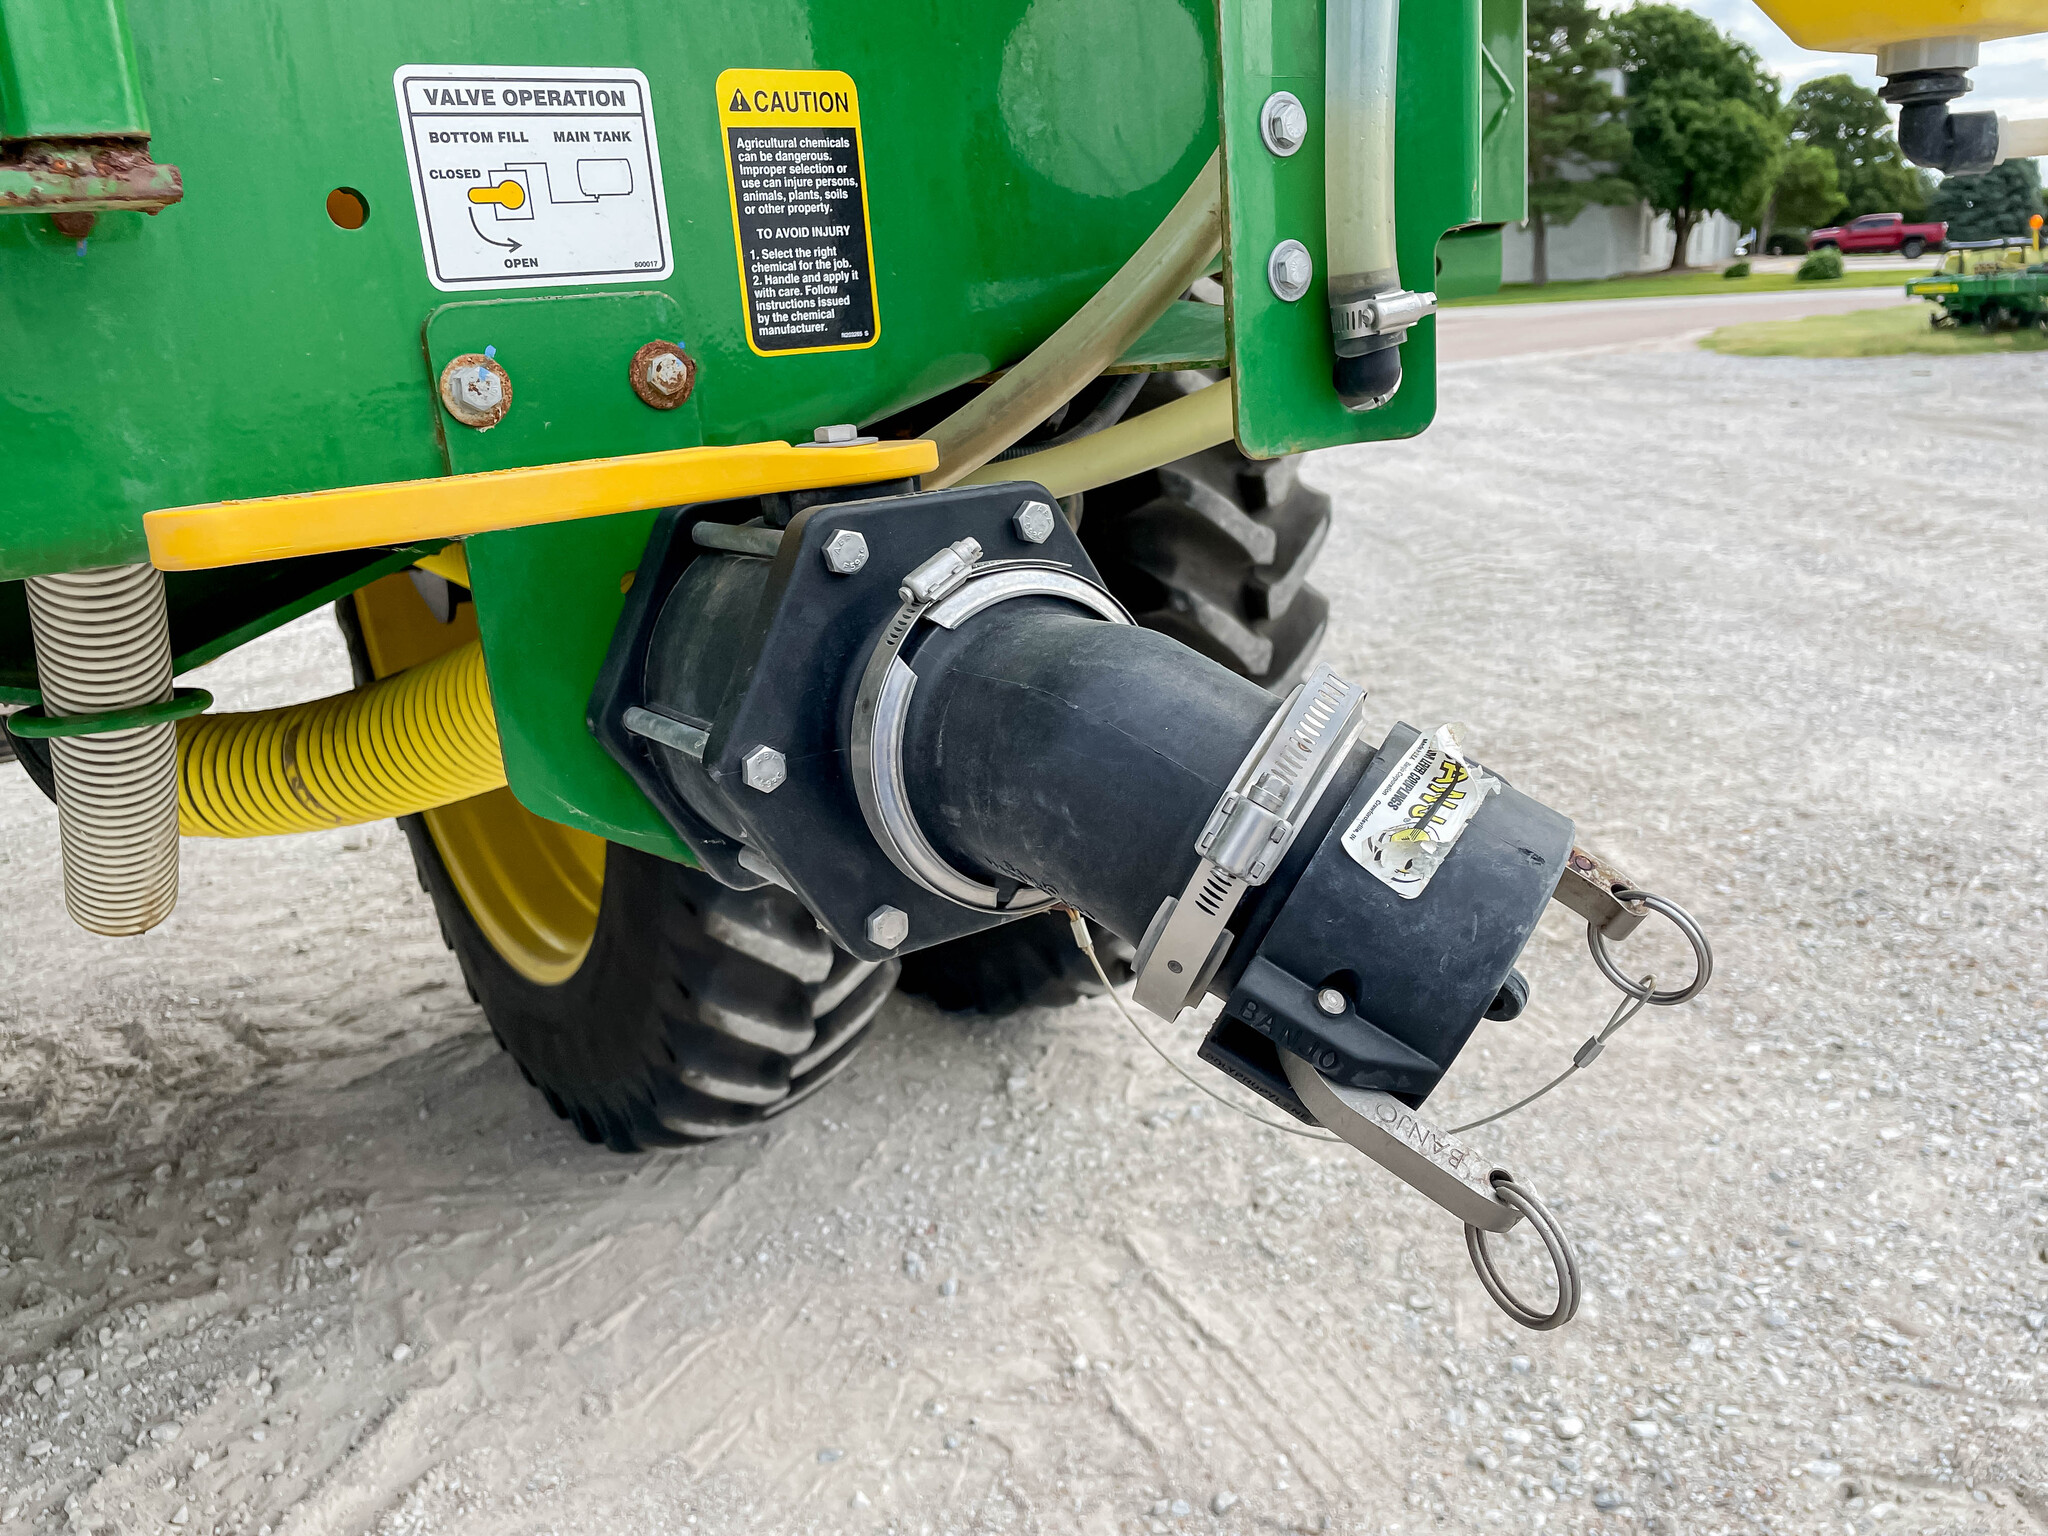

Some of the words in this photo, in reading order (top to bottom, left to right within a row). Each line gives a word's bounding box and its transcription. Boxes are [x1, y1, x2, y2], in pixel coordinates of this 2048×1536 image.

[423, 88, 496, 106] VALVE
[502, 89, 626, 107] OPERATION
[754, 90, 849, 113] CAUTION
[429, 131, 494, 143] BOTTOM
[498, 131, 529, 143] FILL
[553, 131, 591, 143] MAIN
[594, 131, 632, 143] TANK
[737, 137, 797, 151] Agricultural
[799, 137, 850, 149] chemicals
[738, 153, 757, 162] can
[760, 151, 772, 161] be
[775, 151, 832, 163] dangerous.
[429, 169, 481, 179] CLOSED
[740, 164, 786, 177] Improper
[789, 163, 834, 174] selection
[837, 165, 848, 174] or
[741, 179, 760, 188] use
[763, 179, 781, 188] can
[784, 177, 813, 189] injure
[815, 177, 858, 189] persons,
[743, 190, 786, 202] animals,
[788, 189, 822, 202] plants,
[824, 189, 848, 199] soils
[744, 206, 755, 215] or
[758, 203, 785, 214] other
[788, 203, 833, 216] property.
[756, 228, 772, 239] TO
[775, 227, 810, 239] AVOID
[812, 225, 850, 237] INJURY
[750, 249, 760, 260] 1.
[762, 248, 793, 259] Select
[795, 247, 811, 258] the
[814, 246, 837, 259] right
[504, 258, 539, 268] OPEN
[751, 261, 797, 273] chemical
[799, 260, 813, 270] for
[815, 259, 831, 269] the
[833, 258, 852, 271] job.
[753, 276, 762, 286] 2.
[765, 273, 800, 285] Handle
[802, 272, 820, 283] and
[823, 270, 849, 283] apply
[852, 270, 859, 280] it
[754, 287, 776, 299] with
[778, 288, 803, 297] care.
[805, 284, 838, 296] Follow
[756, 298, 816, 311] instructions
[818, 295, 850, 306] issued
[757, 313, 770, 326] by
[772, 312, 789, 323] the
[791, 308, 835, 321] chemical
[759, 323, 828, 336] manufacturer.
[1412, 757, 1432, 775] LEVER
[1382, 771, 1404, 796] Corporation
[1388, 771, 1421, 811] COUPLINGS
[1354, 800, 1381, 833] Crawfordsville,
[1240, 1000, 1338, 1069] BANJO
[1377, 1102, 1466, 1170] BANJO
